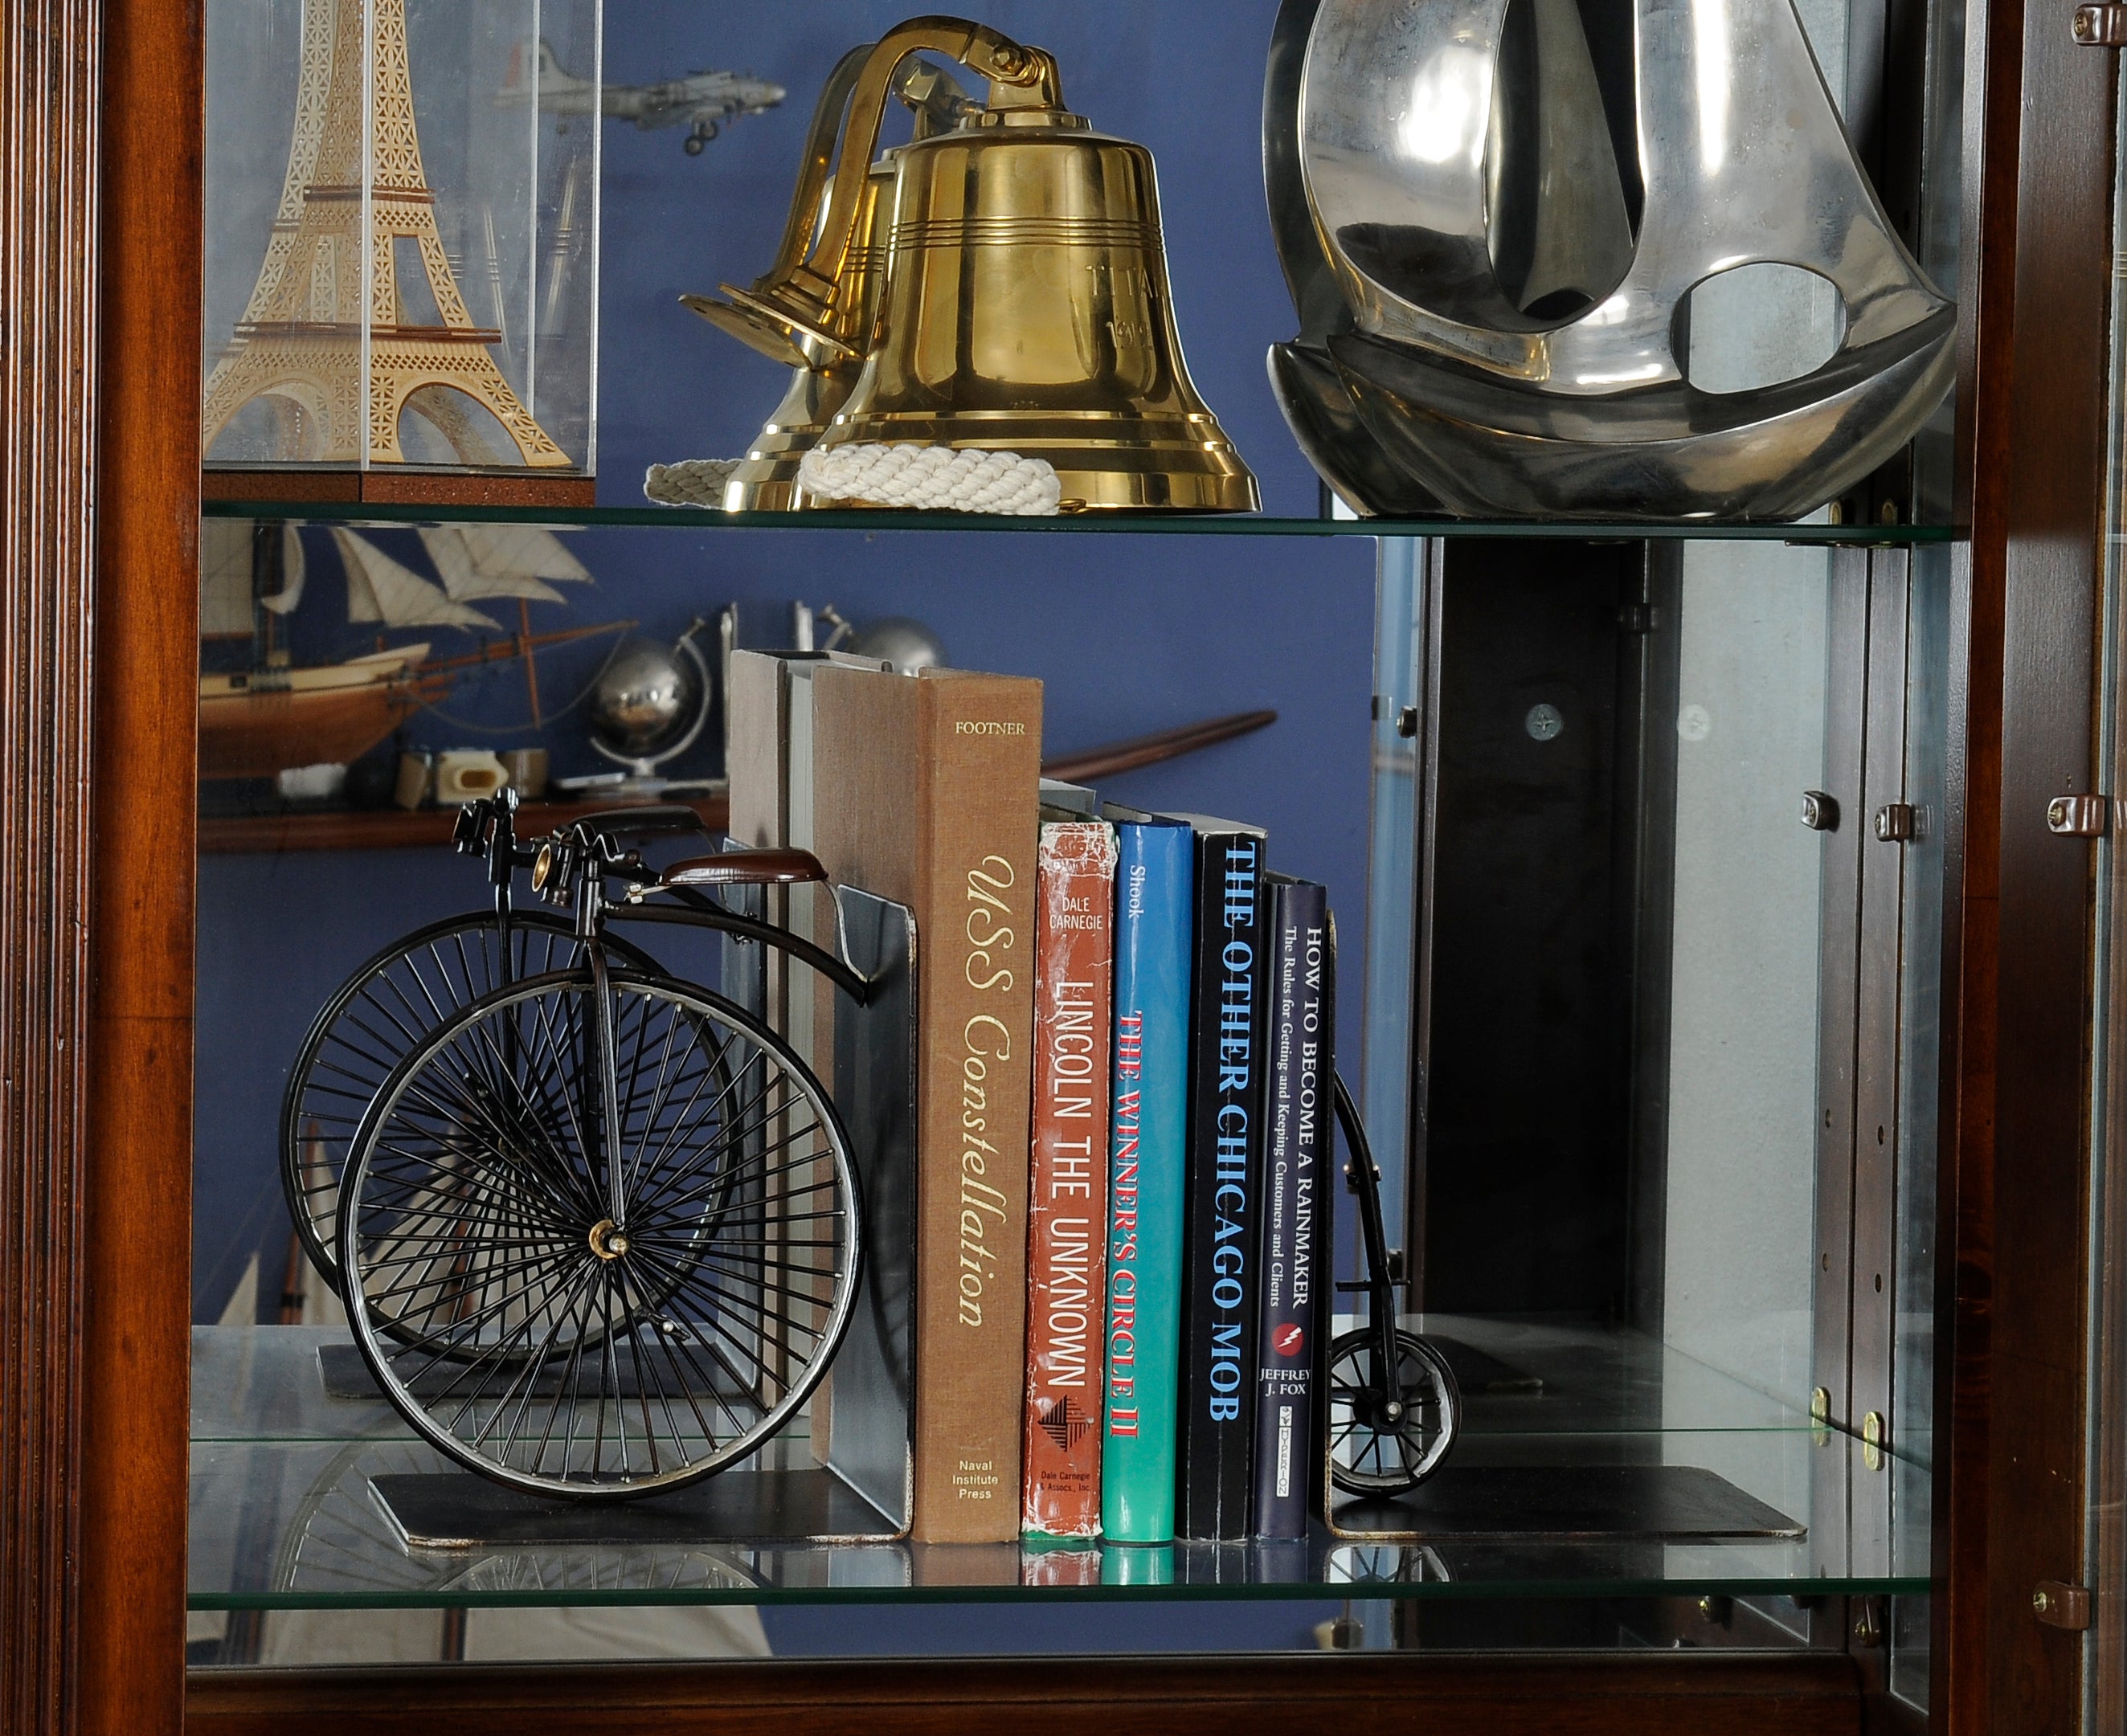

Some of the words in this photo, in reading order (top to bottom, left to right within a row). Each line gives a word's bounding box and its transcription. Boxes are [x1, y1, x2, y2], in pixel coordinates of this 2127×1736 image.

[955, 721, 1025, 735] FOOTNER
[1061, 897, 1090, 913] DALE
[1128, 864, 1146, 920] Shook
[1224, 841, 1256, 928] THE
[966, 855, 1015, 992] USS
[1049, 914, 1103, 930] CARNEGIE
[1284, 925, 1297, 954] The
[1282, 957, 1296, 995] Rules
[1304, 927, 1322, 991] HOW
[1219, 941, 1253, 1093] OTHER
[1281, 998, 1295, 1019] for
[1303, 998, 1319, 1033] TO
[1053, 982, 1094, 1118] LINCOLN
[1118, 1009, 1143, 1081] THE
[1276, 1023, 1294, 1071] Getting
[1278, 1075, 1291, 1099] and
[1299, 1041, 1318, 1146] BECOME
[1273, 1103, 1290, 1157] Keeping
[959, 1015, 1011, 1327] Constellation
[1052, 1135, 1091, 1199] THE
[1114, 1089, 1141, 1262] WINNER'S
[1298, 1151, 1314, 1170] A
[1213, 1104, 1248, 1309] CHICAGO
[1273, 1161, 1288, 1230] Customers
[1272, 1233, 1285, 1258] and
[1292, 1177, 1312, 1309] RAINMAKER
[1047, 1217, 1090, 1387] UNKNOWN
[1269, 1261, 1284, 1308] Clients
[1110, 1268, 1137, 1399] CIRCLE
[1209, 1321, 1241, 1422] MOB
[1259, 1368, 1311, 1382] JEFFREY
[1265, 1383, 1275, 1397] J.
[1279, 1383, 1306, 1395] FOX
[1110, 1406, 1139, 1440] II
[952, 1474, 999, 1485] Institute
[959, 1460, 992, 1471] Naval
[1041, 1471, 1057, 1480] Dale
[1059, 1472, 1090, 1481] Carnegie
[1278, 1428, 1290, 1494] HYPERION
[959, 1488, 992, 1500] Press
